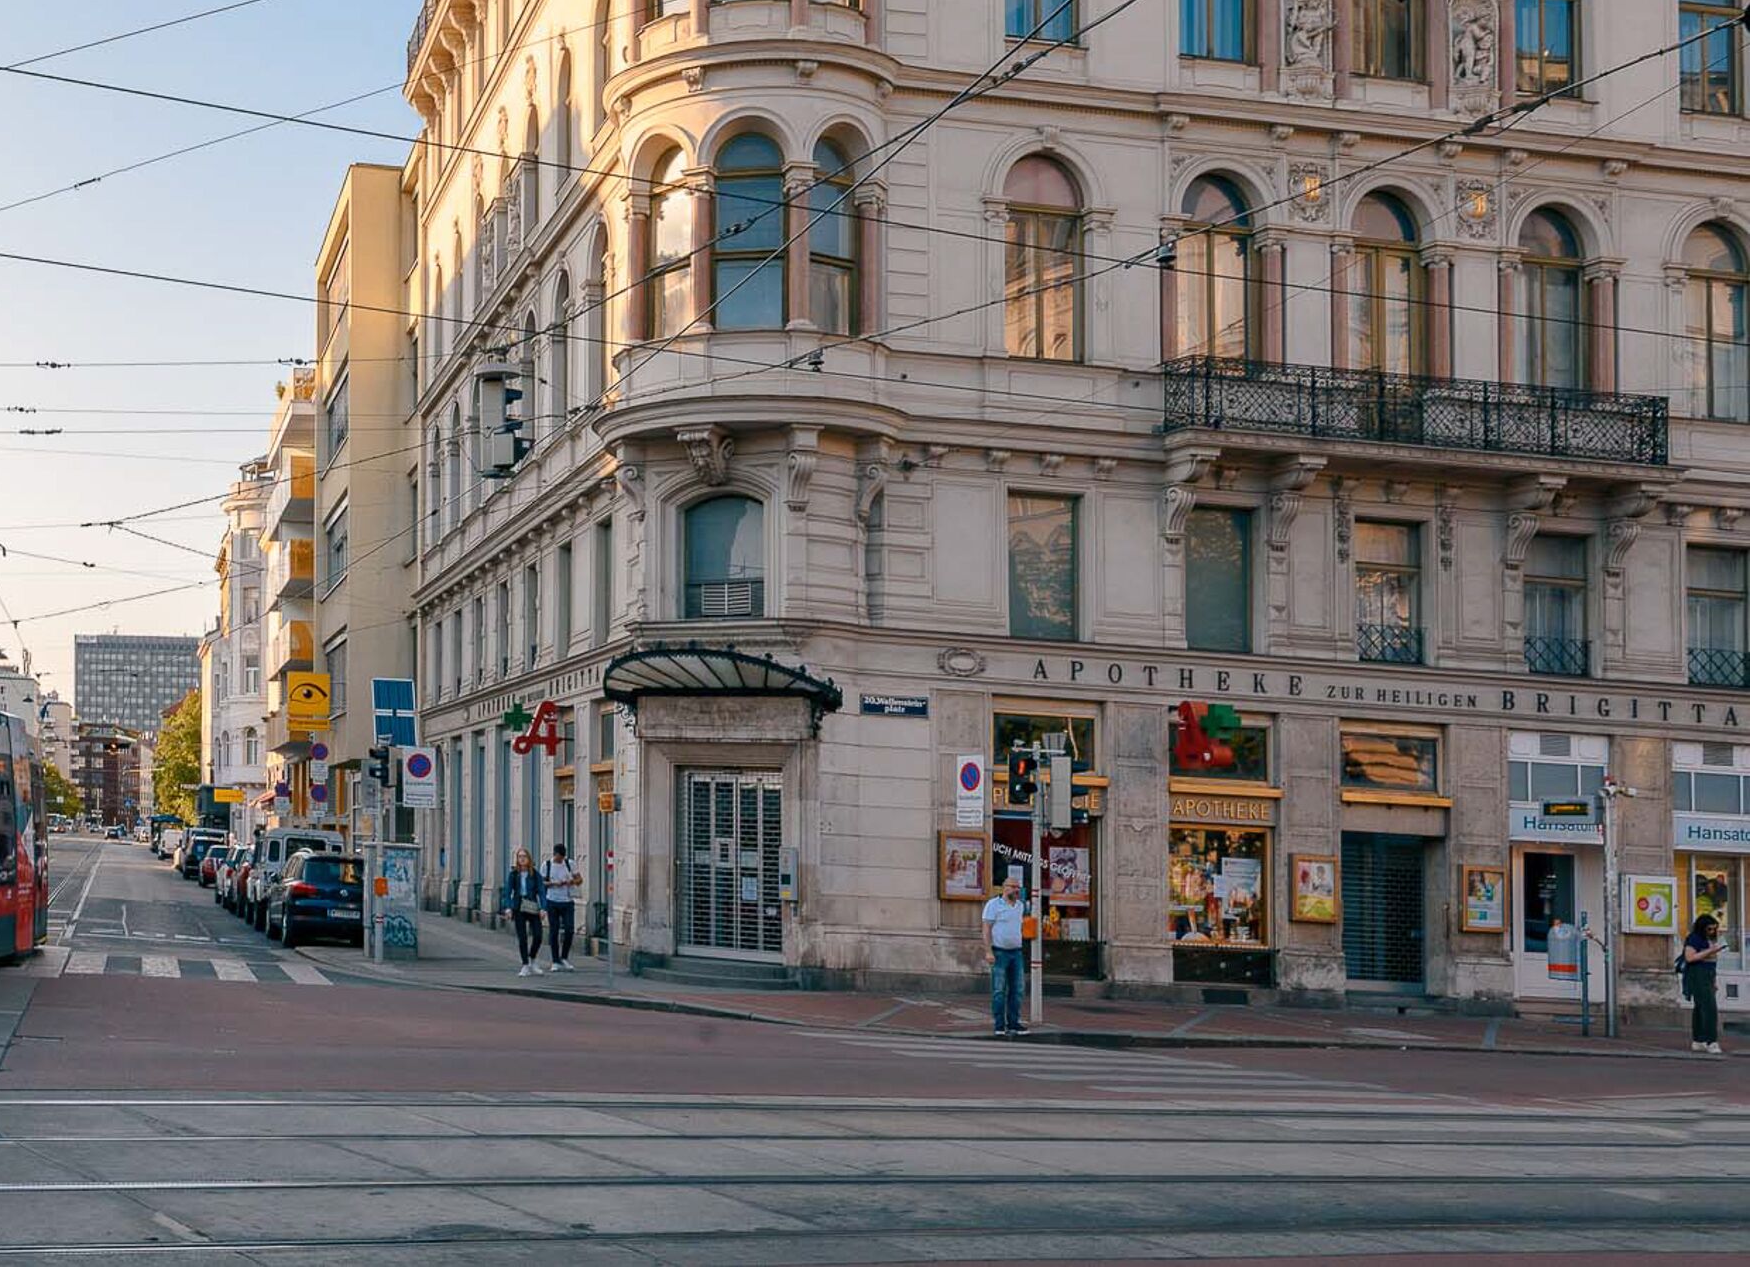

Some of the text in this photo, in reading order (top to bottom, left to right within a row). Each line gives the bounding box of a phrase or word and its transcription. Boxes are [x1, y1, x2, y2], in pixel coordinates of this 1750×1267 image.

[1032, 658, 1739, 727] APOTHEKE ZUR HEILIGEN BRIGITTA
[1173, 798, 1270, 821] APOTHEKE
